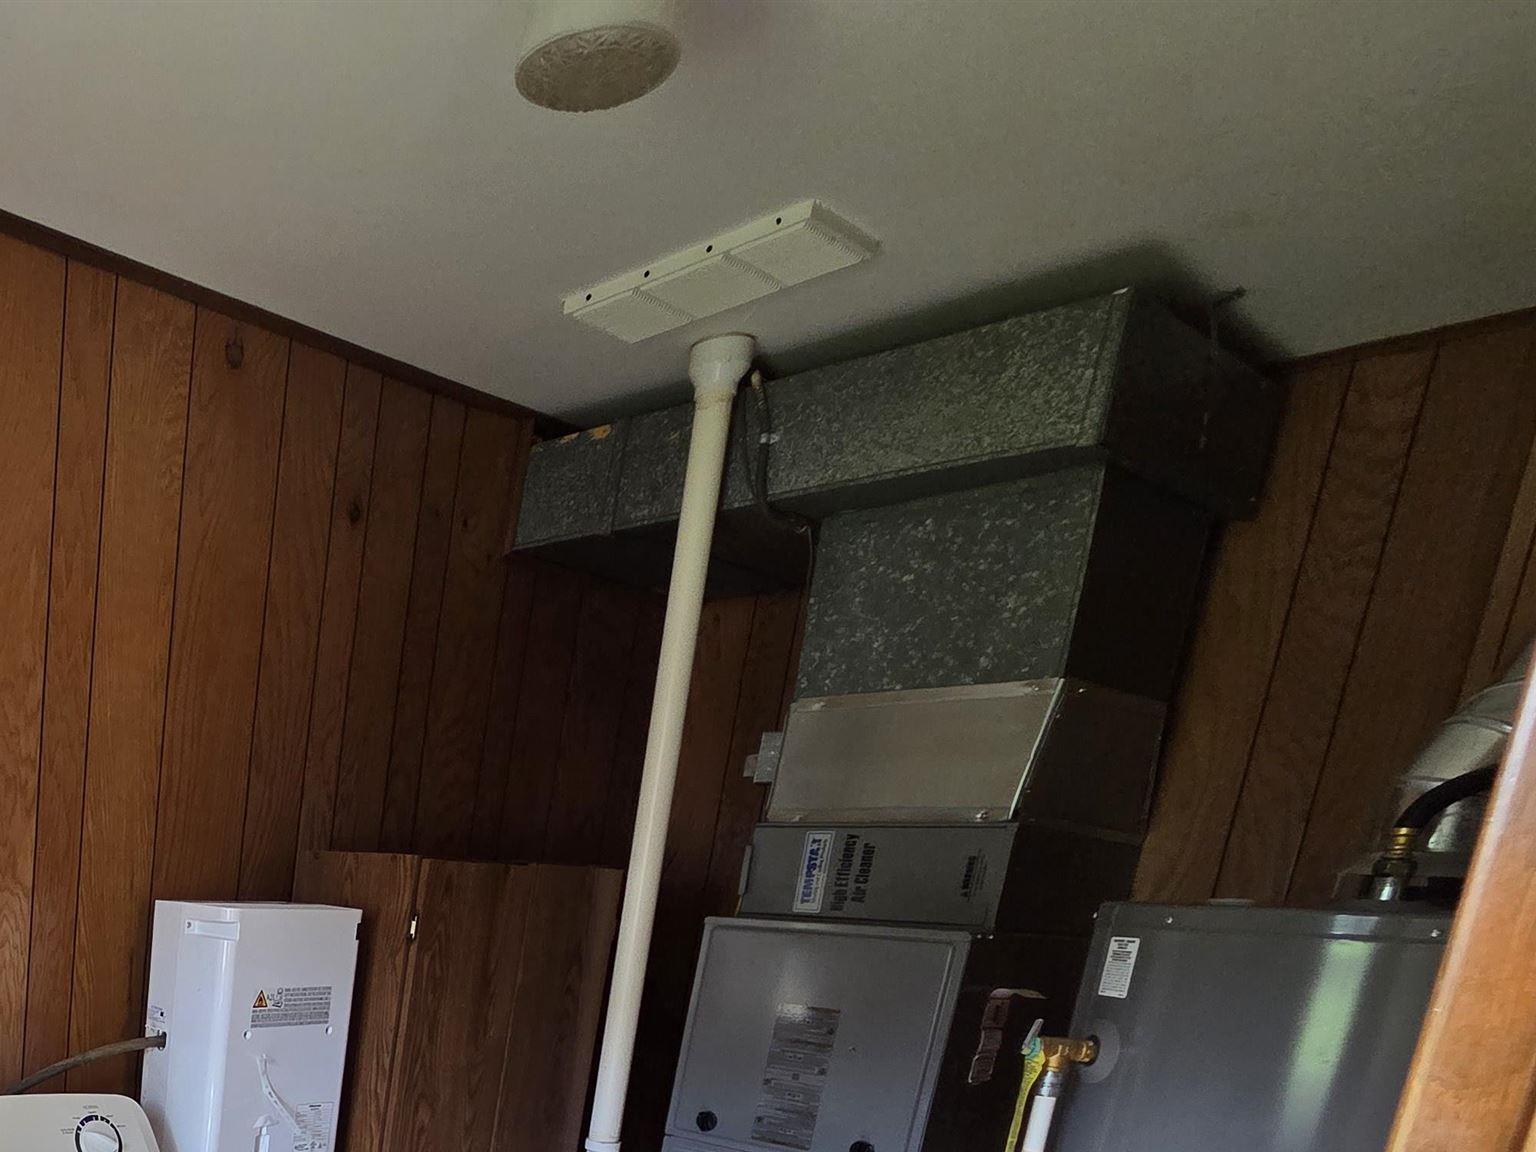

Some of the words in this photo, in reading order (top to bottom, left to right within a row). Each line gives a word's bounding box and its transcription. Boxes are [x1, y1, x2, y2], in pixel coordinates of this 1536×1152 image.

[835, 834, 860, 887] Efficiency
[854, 842, 875, 884] Cleaner
[851, 886, 866, 903] Air
